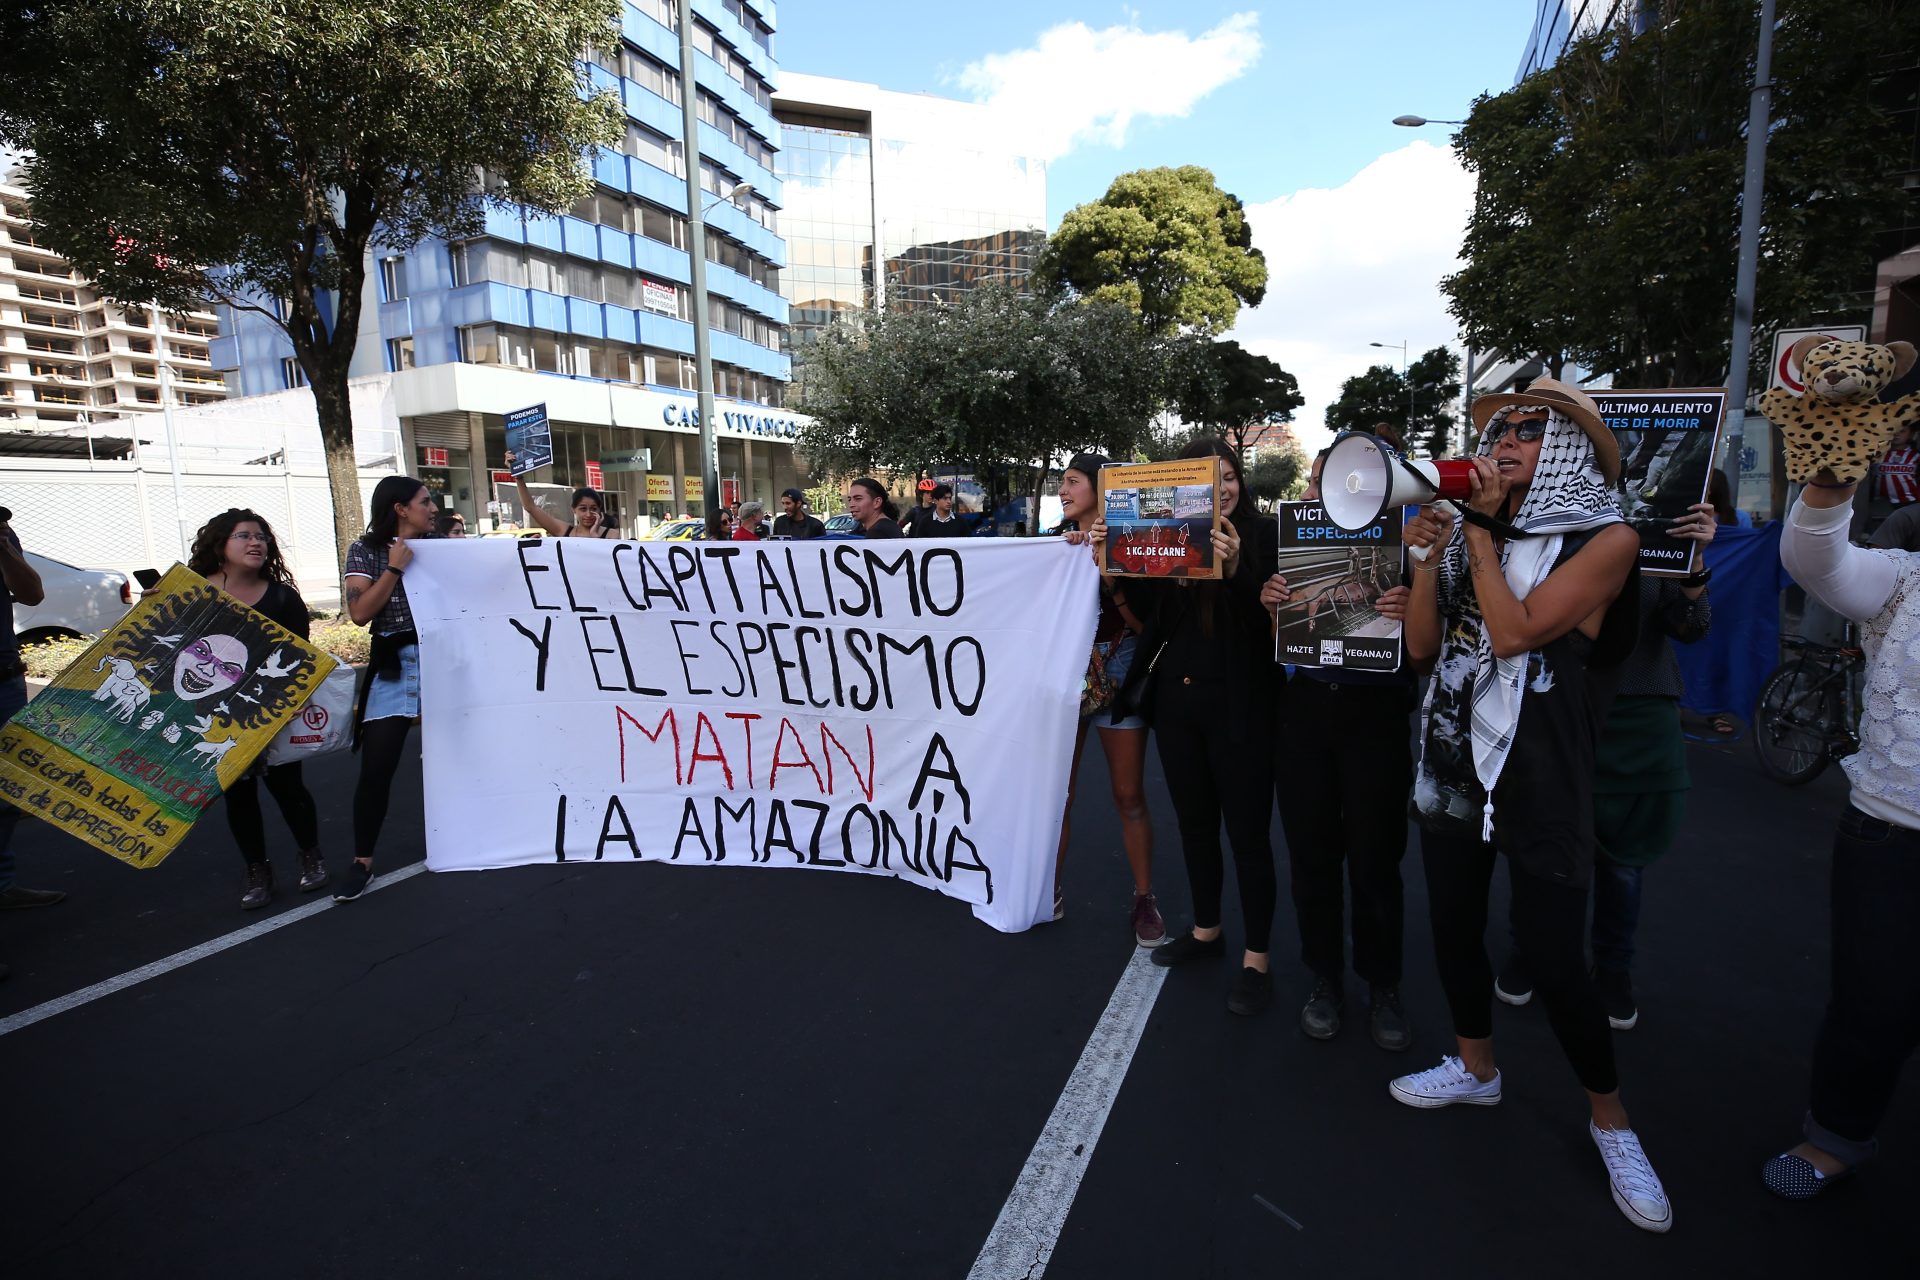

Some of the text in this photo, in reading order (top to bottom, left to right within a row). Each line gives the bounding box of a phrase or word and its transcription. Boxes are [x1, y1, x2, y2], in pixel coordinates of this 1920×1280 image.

[510, 407, 539, 420] PODEMOS
[663, 403, 699, 428] CAS
[1599, 401, 1713, 414] ÚLTIMO ALIENTO
[507, 413, 543, 429] PARAR ESTO
[1601, 417, 1700, 429] TES DE MORIR
[648, 478, 670, 487] Oferta
[646, 487, 657, 495] del
[1293, 505, 1328, 521] VÍCT
[1126, 547, 1186, 557] 1 KG. DE CARNE
[1640, 549, 1684, 559] EGANA/O
[518, 540, 964, 618] EL CAPITALISMO
[1286, 645, 1314, 655] HAZTE
[1345, 648, 1392, 660] VEGANA/O
[509, 615, 985, 716] Y EL ESPECISMO
[615, 705, 970, 824] MATAN A
[39, 761, 94, 798] contra
[96, 785, 141, 822] todas
[142, 810, 170, 837] las
[28, 788, 52, 810] de
[51, 800, 154, 861] OPRESIÓN
[671, 789, 994, 905] AMAZONÍA
